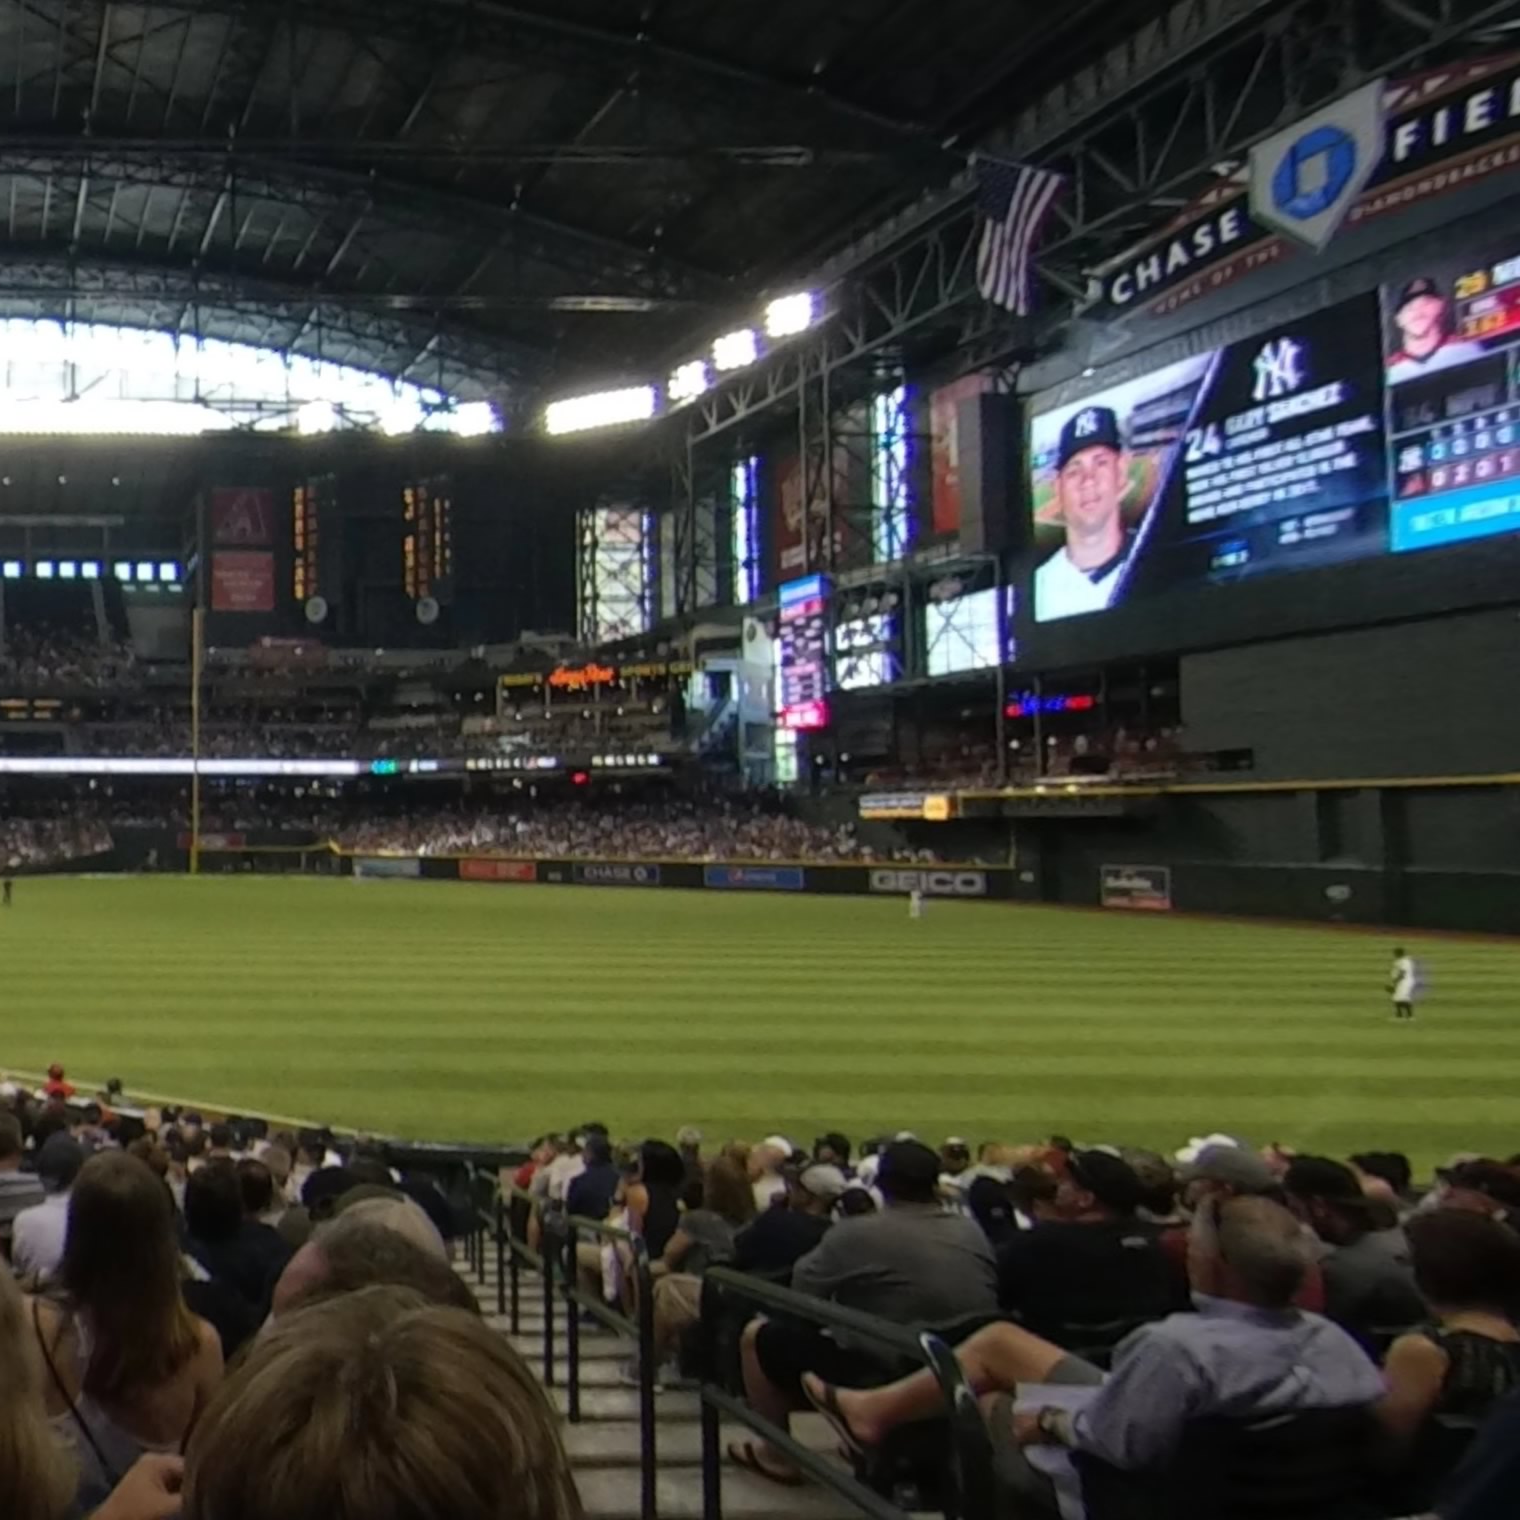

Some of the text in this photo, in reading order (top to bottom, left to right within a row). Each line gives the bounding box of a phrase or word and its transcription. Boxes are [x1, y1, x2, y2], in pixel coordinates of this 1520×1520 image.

[1111, 207, 1242, 304] CHASE
[1185, 421, 1221, 462] 24
[1432, 471, 1446, 487] 0
[583, 866, 631, 880] CHASE
[870, 869, 984, 893] GEICO
